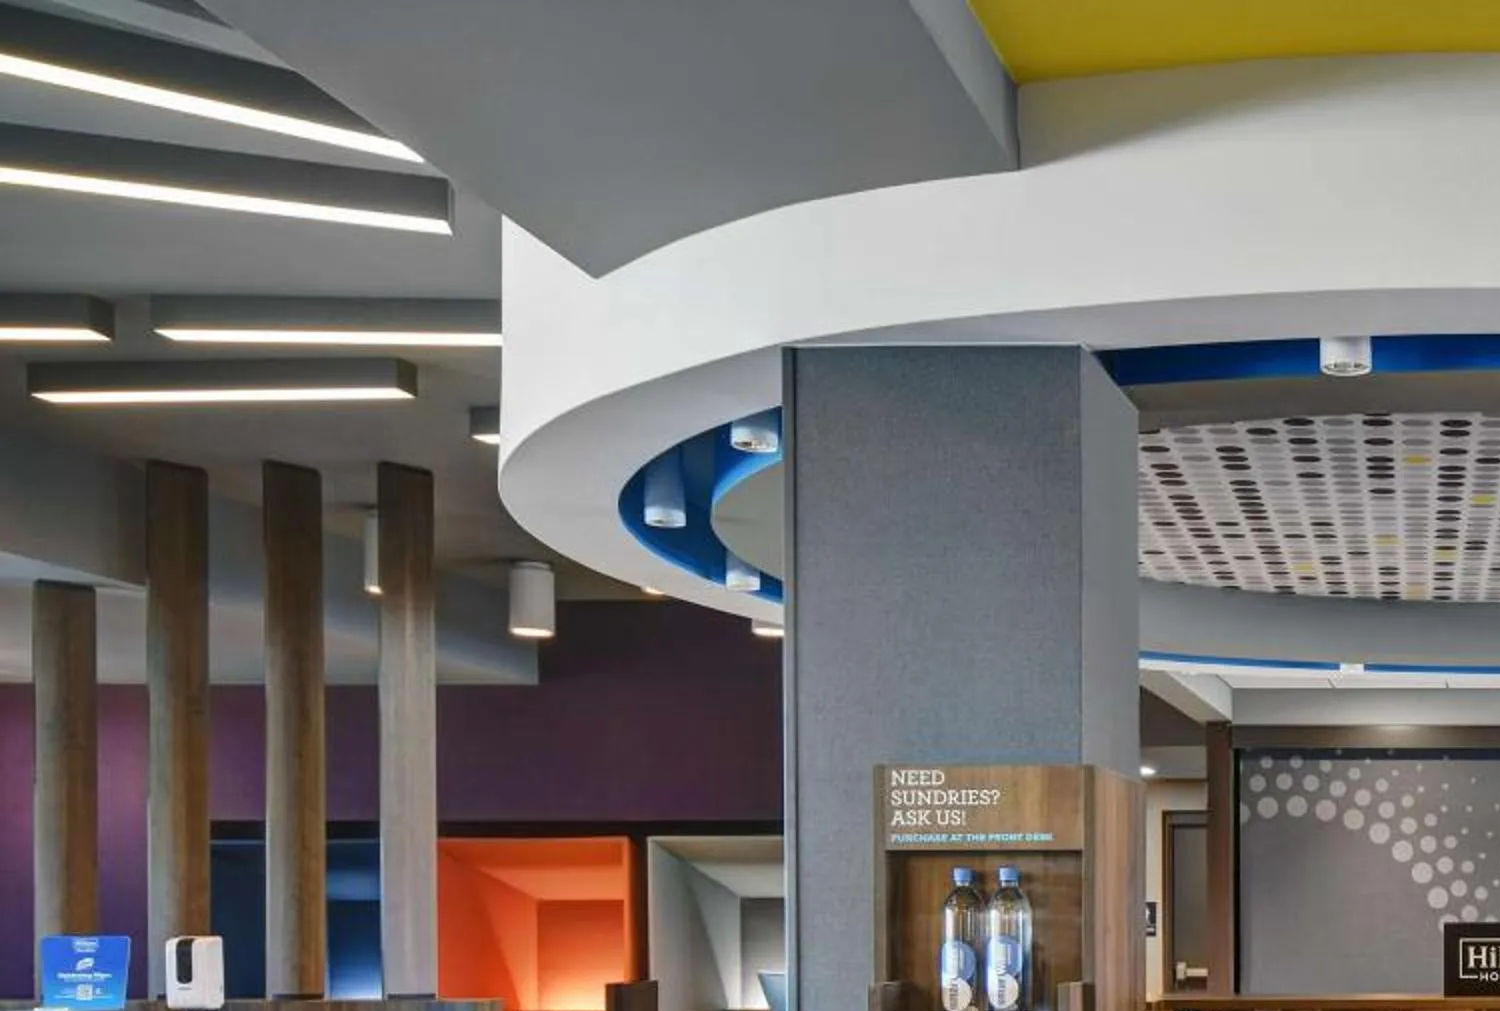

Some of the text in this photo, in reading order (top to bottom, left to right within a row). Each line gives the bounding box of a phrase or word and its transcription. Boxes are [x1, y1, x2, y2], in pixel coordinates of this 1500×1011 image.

[891, 769, 945, 787] NEED
[890, 789, 1000, 807] SUNDRIES?
[890, 809, 968, 827] ASK US!
